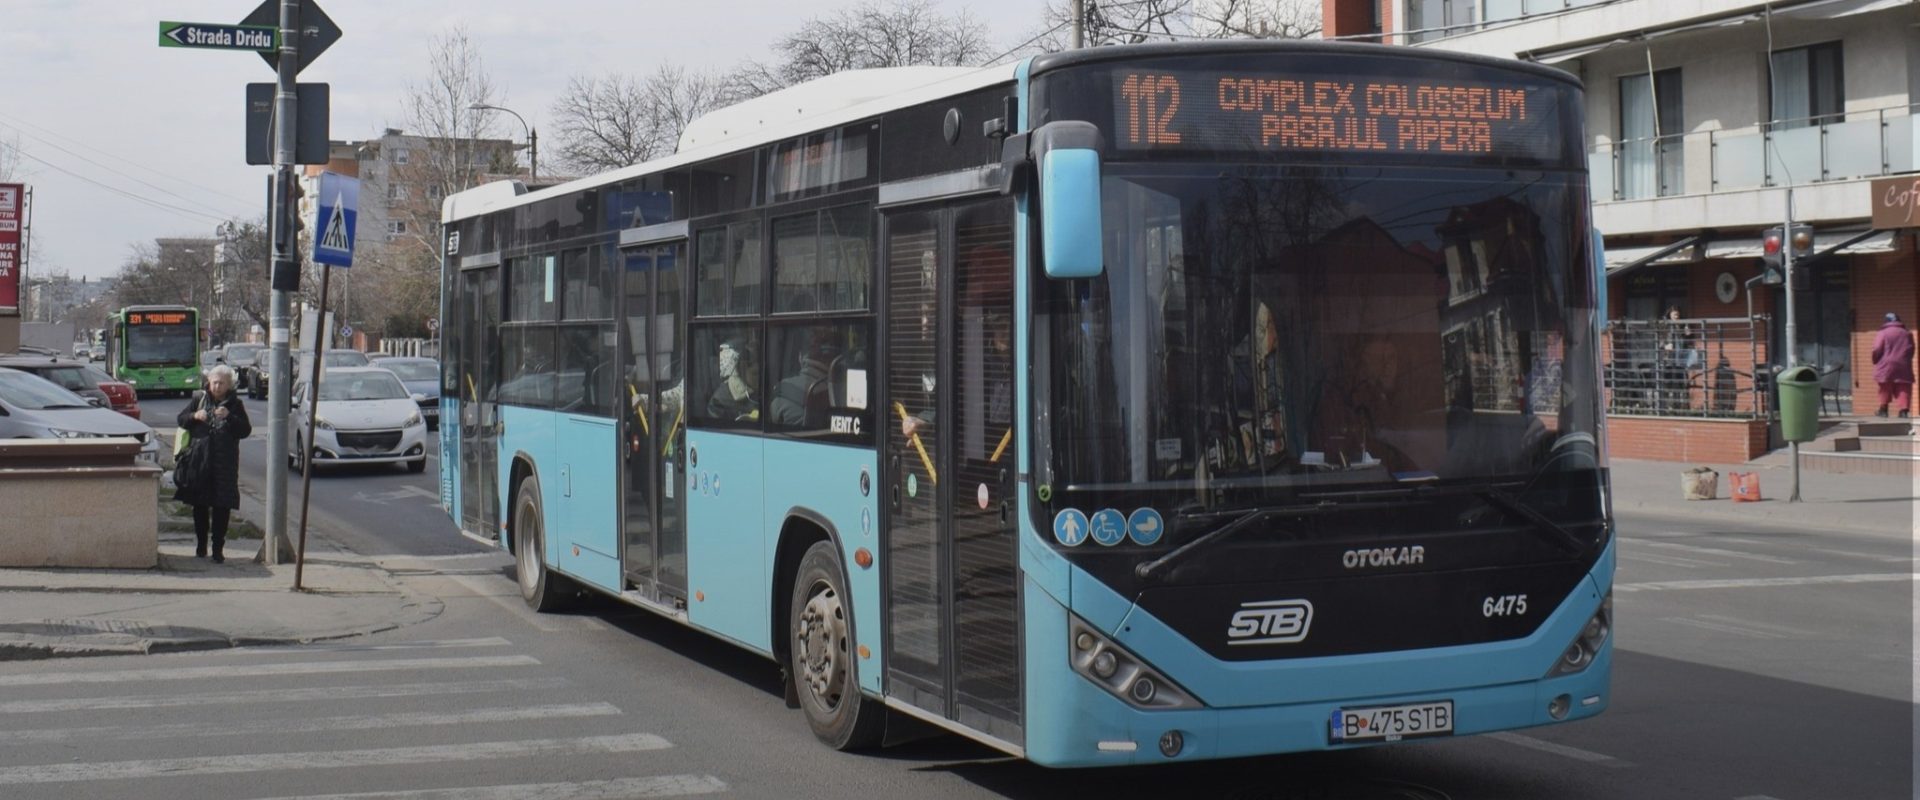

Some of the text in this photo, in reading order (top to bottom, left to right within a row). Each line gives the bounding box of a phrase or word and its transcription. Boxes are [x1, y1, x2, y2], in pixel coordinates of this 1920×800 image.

[187, 27, 271, 47] Strada Dridu
[1122, 74, 1526, 144] 112 COMPLEX COLOSSEUM
[1262, 114, 1491, 152] PASAJUL PIPERA
[1884, 181, 1920, 223] Cof
[831, 415, 860, 435] KENT C
[1343, 546, 1424, 568] OTOKAR
[1483, 595, 1527, 617] 6475
[1228, 606, 1306, 638] STB
[1369, 711, 1404, 734] 475
[1408, 706, 1448, 731] STB
